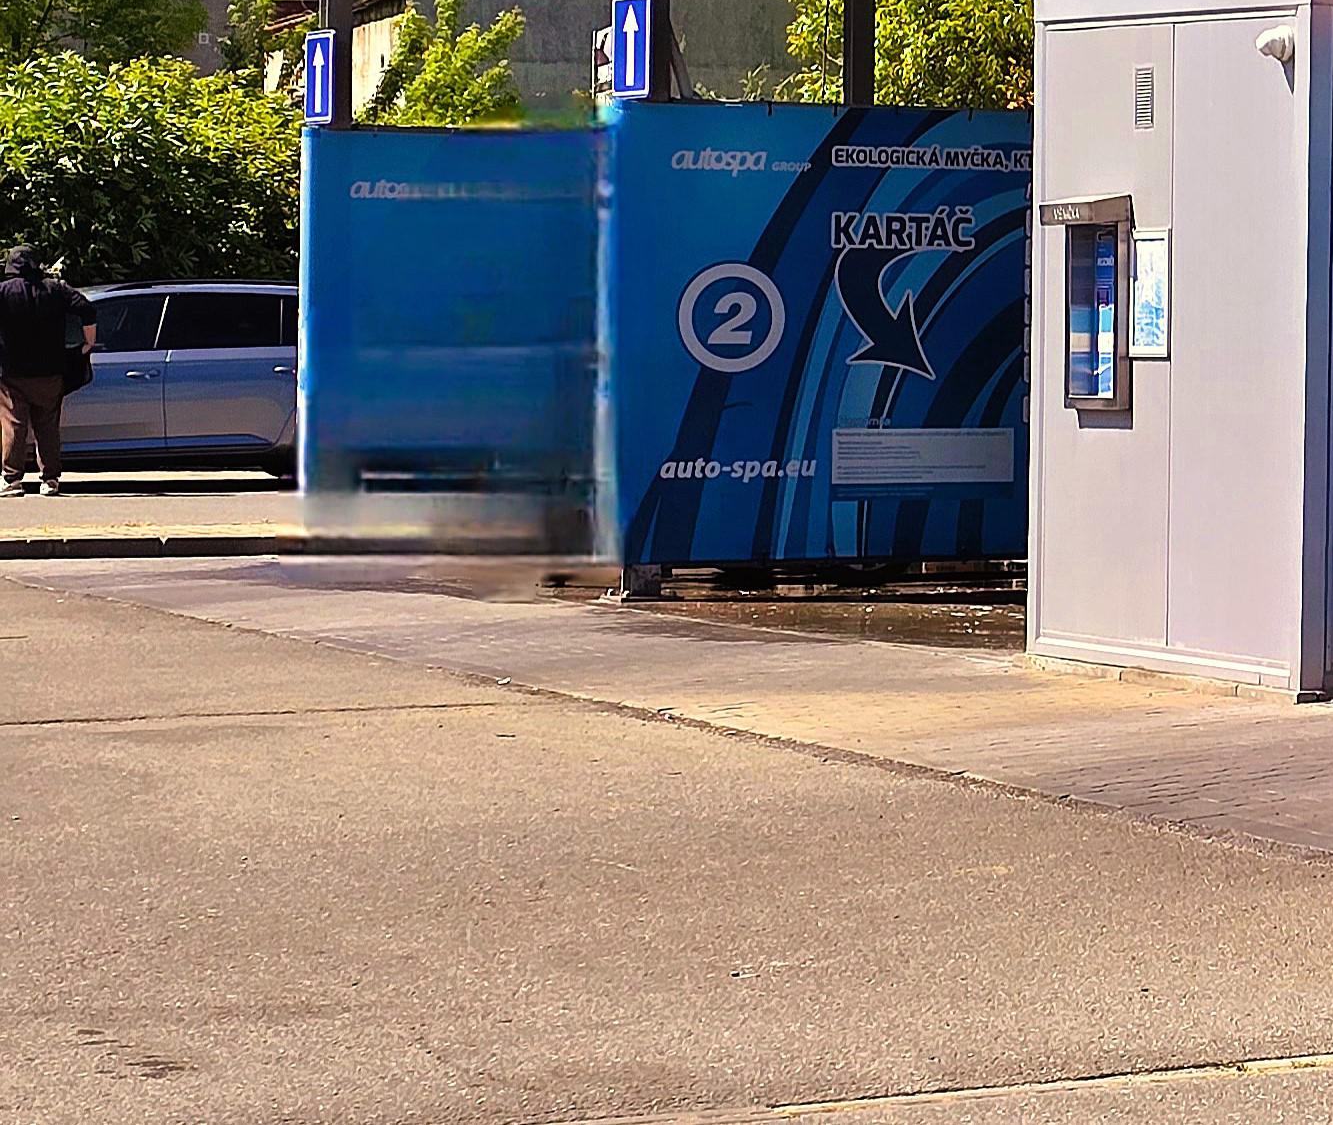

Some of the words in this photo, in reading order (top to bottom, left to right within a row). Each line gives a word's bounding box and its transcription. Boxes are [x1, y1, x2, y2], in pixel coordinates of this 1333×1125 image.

[671, 147, 768, 177] autospa
[772, 161, 811, 173] GROUP
[832, 145, 940, 167] EKOLOGICKÁ
[944, 146, 1010, 171] MYČKA,
[832, 206, 975, 250] KARTÁČ
[708, 291, 757, 345] 2
[660, 457, 817, 483] auto-spa.eu
